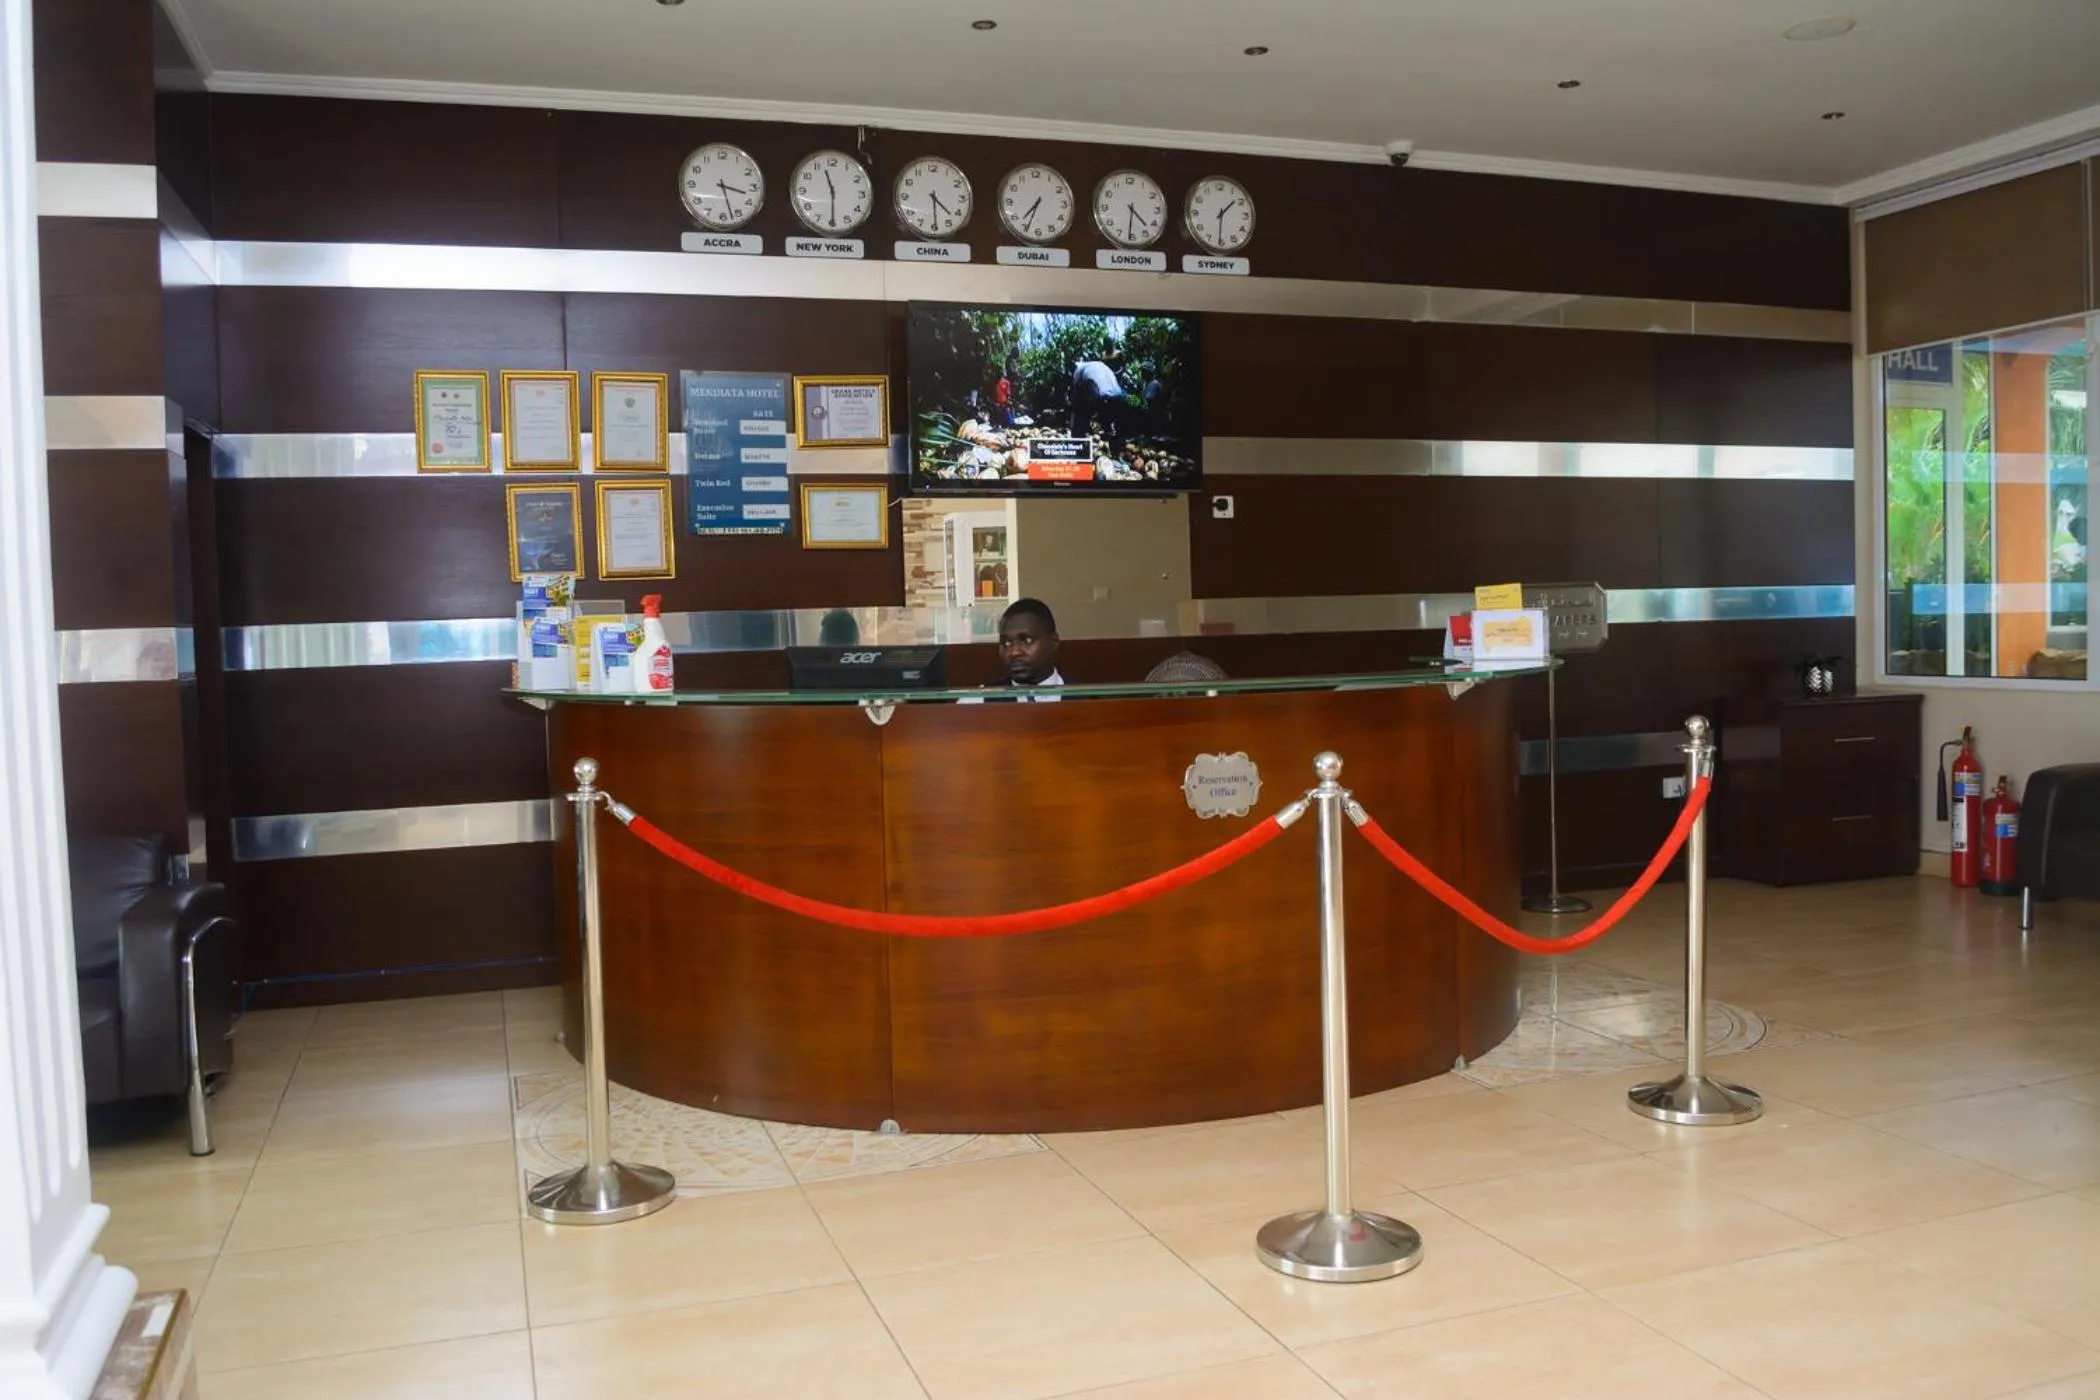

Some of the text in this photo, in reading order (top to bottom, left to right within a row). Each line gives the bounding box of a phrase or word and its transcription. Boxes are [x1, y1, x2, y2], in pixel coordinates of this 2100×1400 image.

[703, 238, 741, 248] ACCRA
[796, 242, 854, 253] NEW YORK
[916, 247, 949, 257] CHINA
[1017, 251, 1050, 261] DUBAI
[1111, 255, 1152, 265] LONDON
[1197, 260, 1235, 270] SYDNEY
[1887, 351, 1939, 372] HALL
[746, 388, 780, 399] HOTEL
[695, 479, 715, 488] Twin
[840, 651, 882, 664] acer
[1209, 786, 1237, 798] Office
